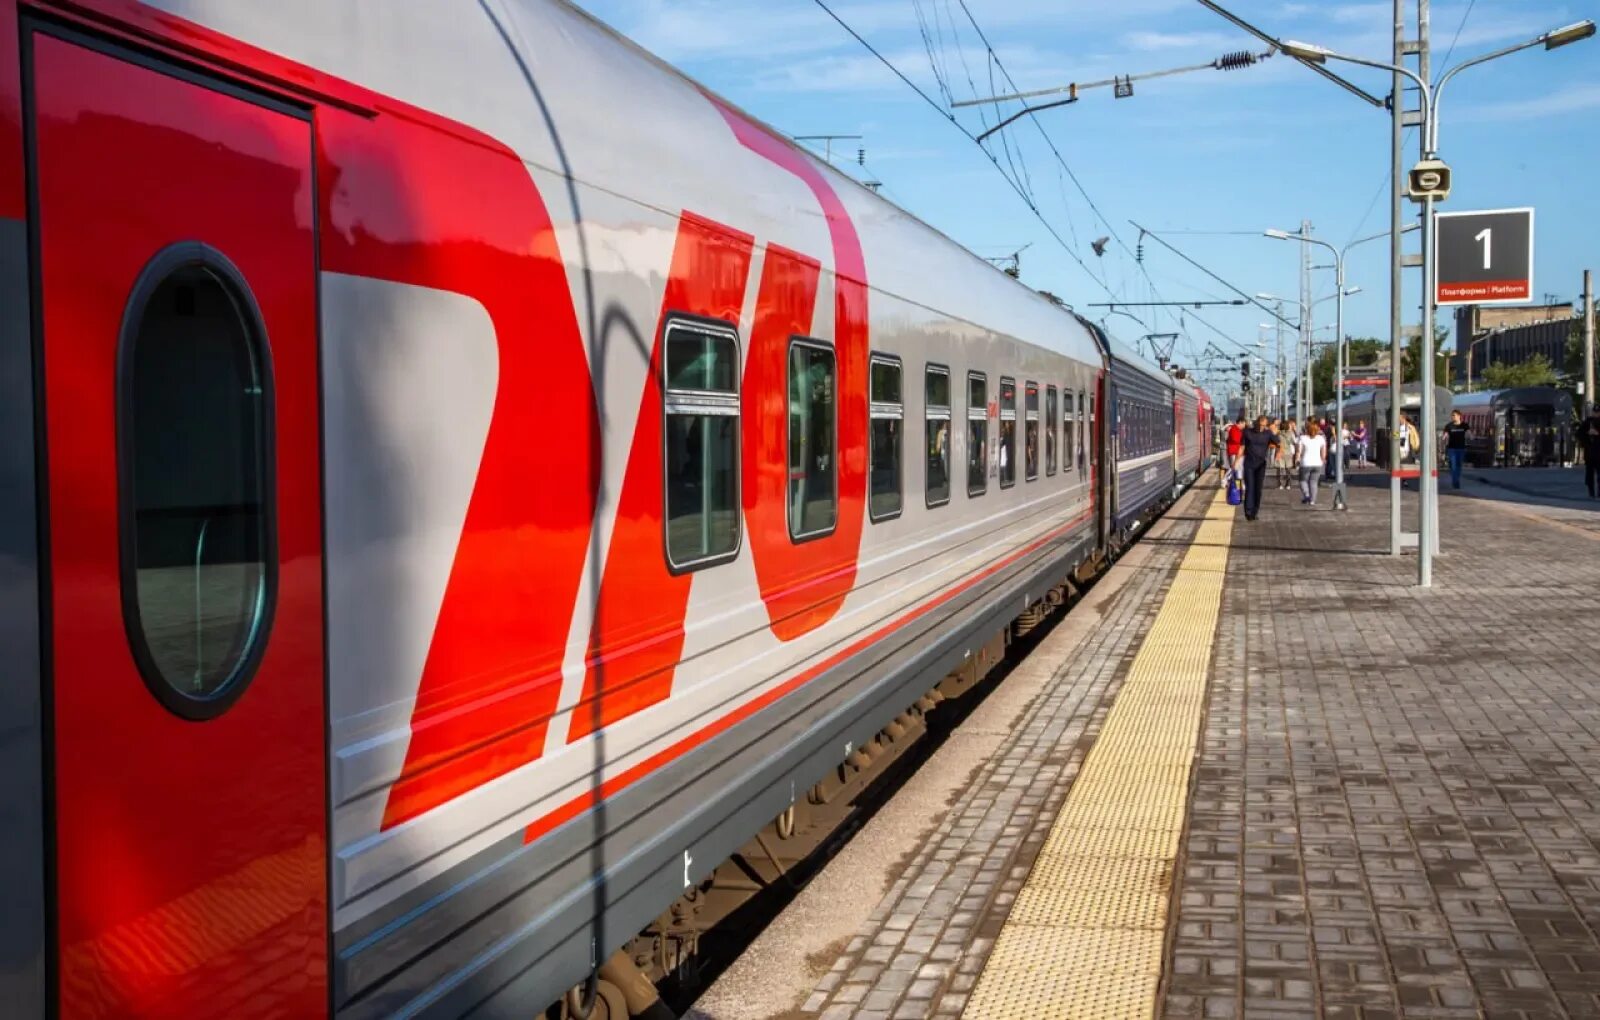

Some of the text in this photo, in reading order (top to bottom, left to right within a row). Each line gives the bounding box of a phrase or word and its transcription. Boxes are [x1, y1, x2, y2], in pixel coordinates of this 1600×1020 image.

[1474, 228, 1492, 269] 1
[1440, 287, 1486, 296] Платформа
[1491, 285, 1525, 294] Platform
